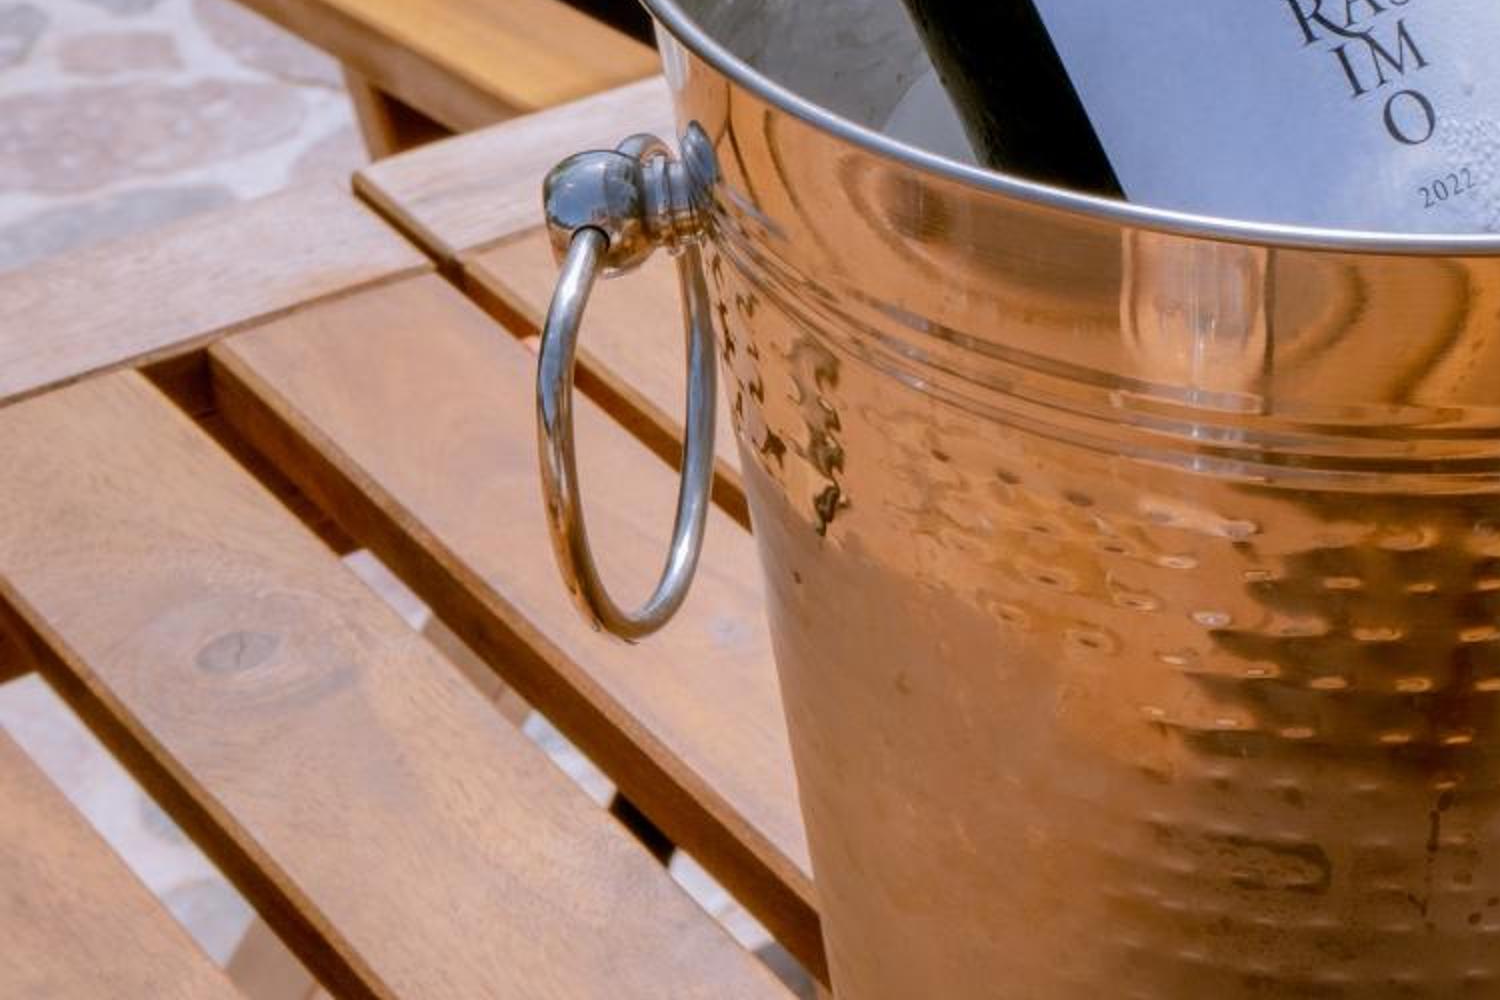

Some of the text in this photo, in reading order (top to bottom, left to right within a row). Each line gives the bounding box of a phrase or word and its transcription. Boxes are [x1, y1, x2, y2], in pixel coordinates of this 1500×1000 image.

[1329, 18, 1429, 98] IM
[1383, 89, 1437, 146] O
[1418, 167, 1476, 209] 2022
